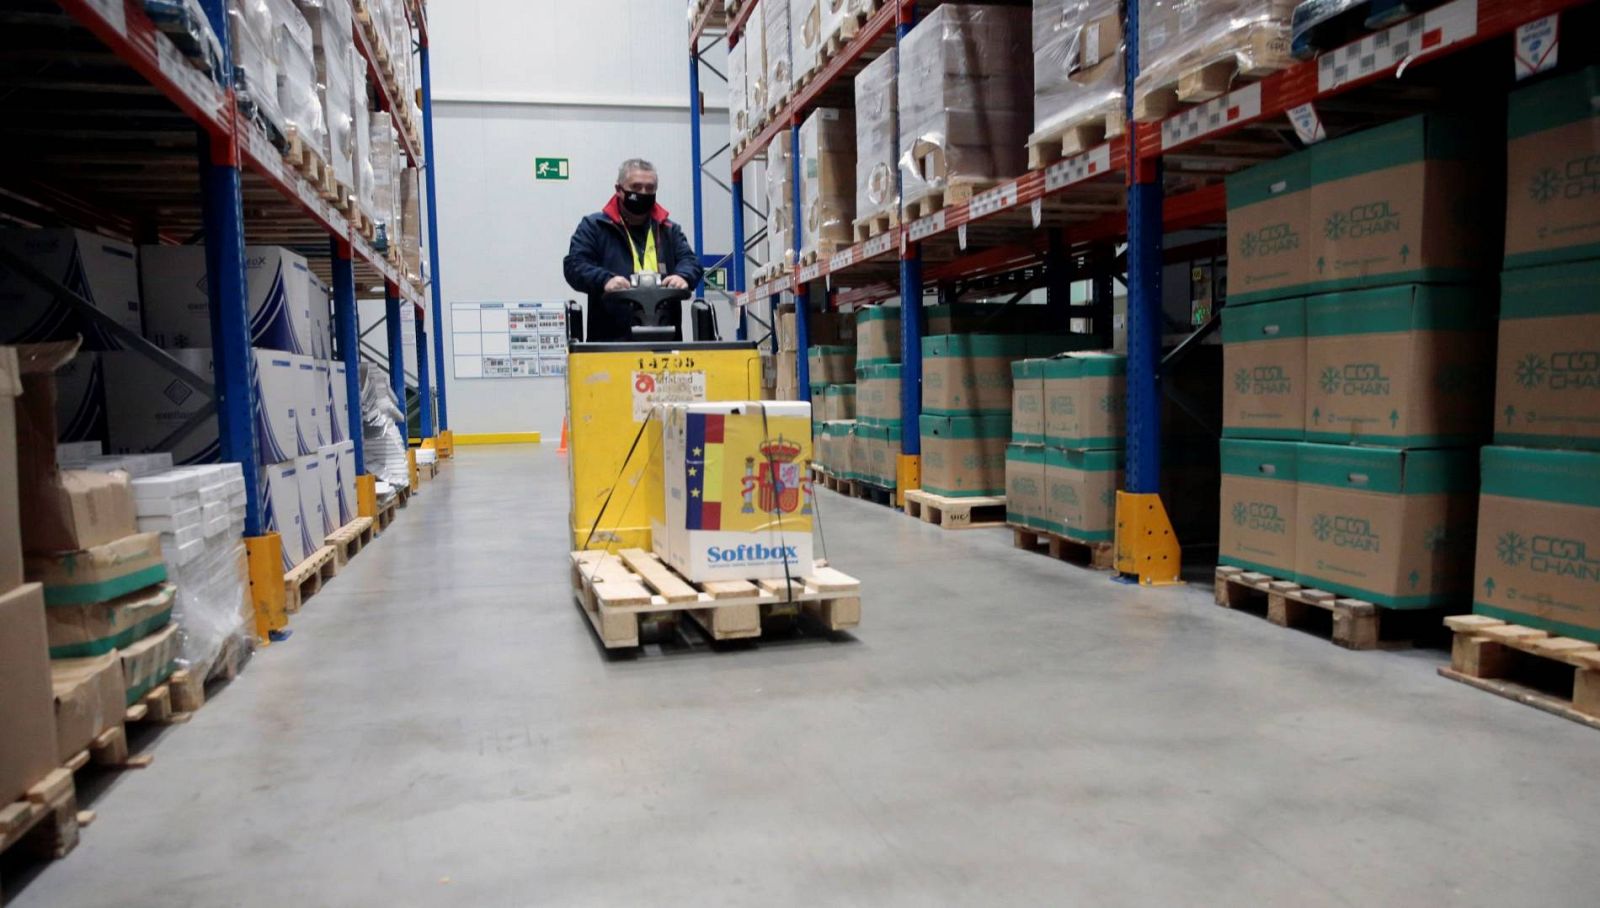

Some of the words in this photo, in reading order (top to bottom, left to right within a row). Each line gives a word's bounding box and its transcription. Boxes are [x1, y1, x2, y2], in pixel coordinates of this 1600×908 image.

[1350, 201, 1400, 222] COOL
[1350, 219, 1400, 238] CHAIN
[1258, 237, 1299, 256] CHAIN
[1254, 365, 1291, 382] COOL
[1344, 364, 1391, 382] COOL
[1254, 379, 1291, 395] CHAIN
[1343, 379, 1390, 396] CHAIN
[1250, 503, 1285, 521] COOL
[1249, 517, 1285, 535] CHAIN
[1334, 516, 1380, 538] COOL
[707, 543, 797, 562] Softbox
[1334, 532, 1380, 554] CHAIN
[1531, 535, 1600, 563] COOL
[1530, 556, 1600, 583] CHAIN
